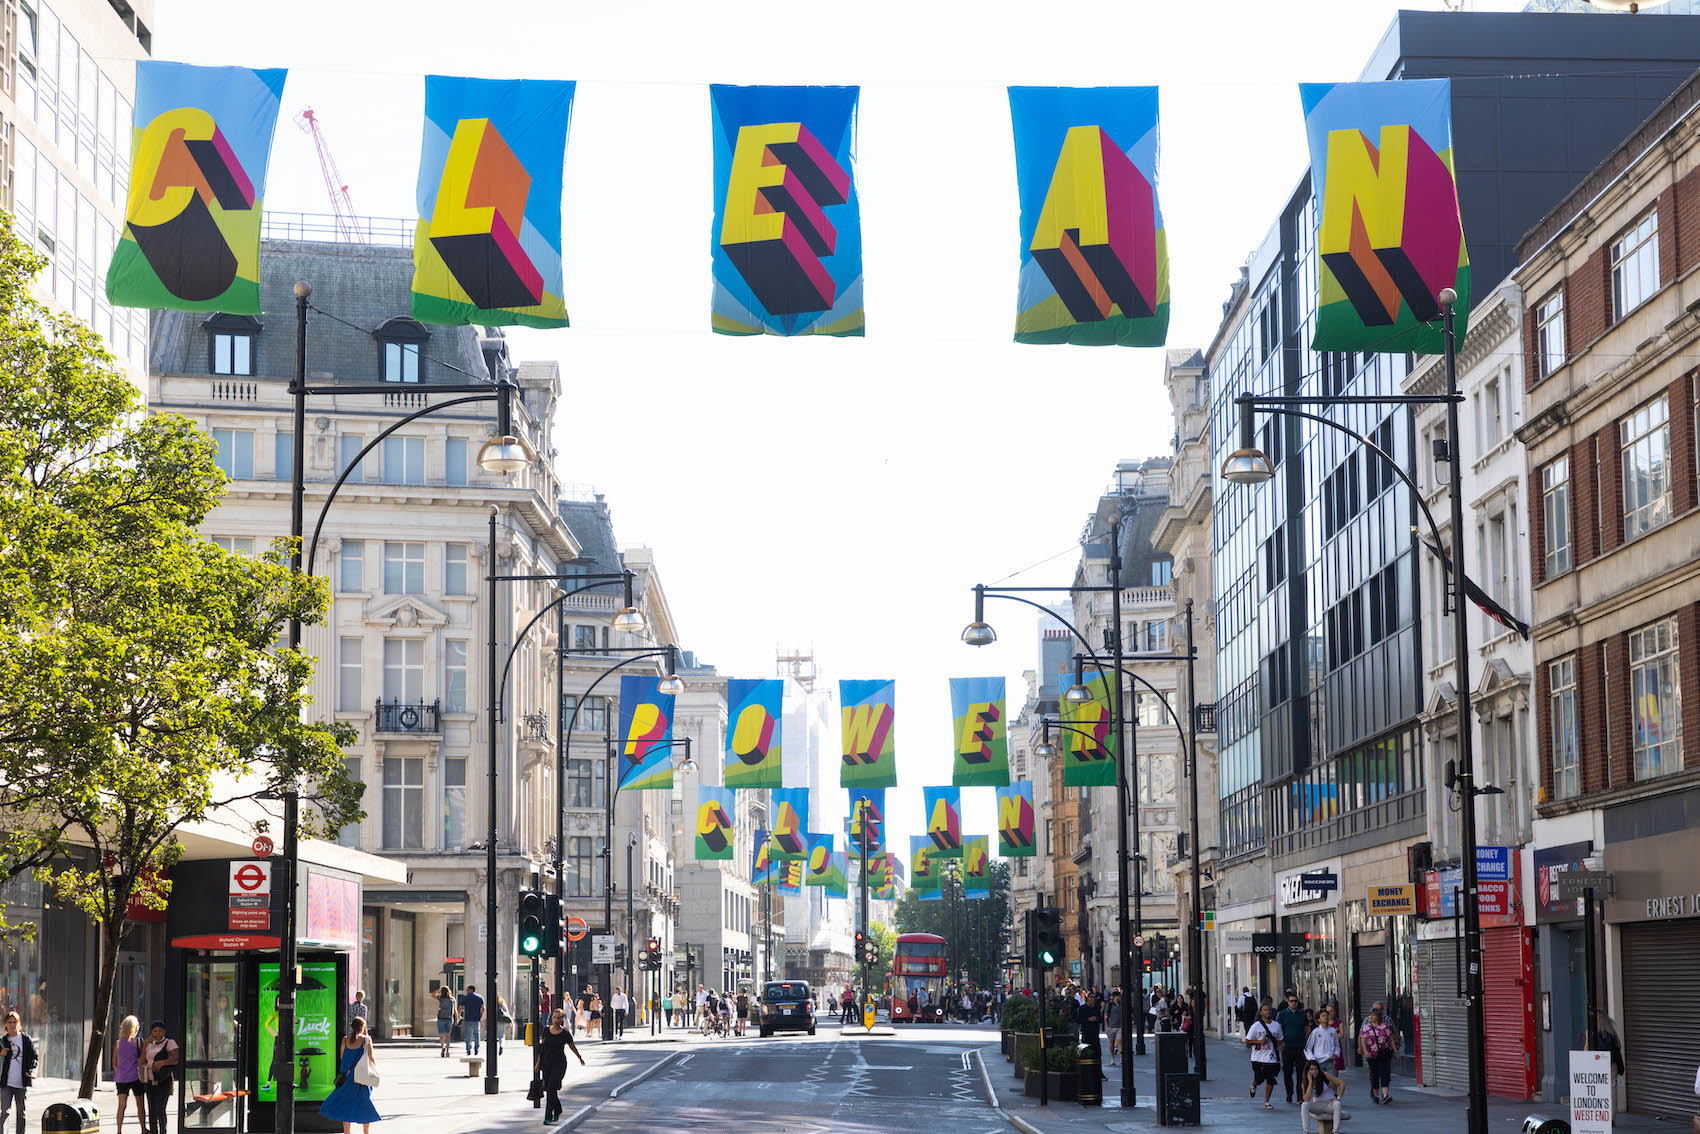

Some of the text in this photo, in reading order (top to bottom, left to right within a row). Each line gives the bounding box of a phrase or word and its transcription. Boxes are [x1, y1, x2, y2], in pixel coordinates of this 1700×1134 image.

[1477, 862, 1505, 872] CHANGE
[1377, 887, 1403, 896] MONEY
[1477, 884, 1504, 892] BACCO
[1372, 897, 1411, 908] EXCHANGE
[1646, 896, 1685, 917] ERNEST
[1478, 904, 1501, 913] RINKS
[297, 1017, 331, 1036] Luck
[1573, 1072, 1609, 1084] WELCOME
[1586, 1085, 1596, 1096] TO
[1573, 1097, 1609, 1109] LONDON'S
[1574, 1110, 1609, 1121] WEST END
